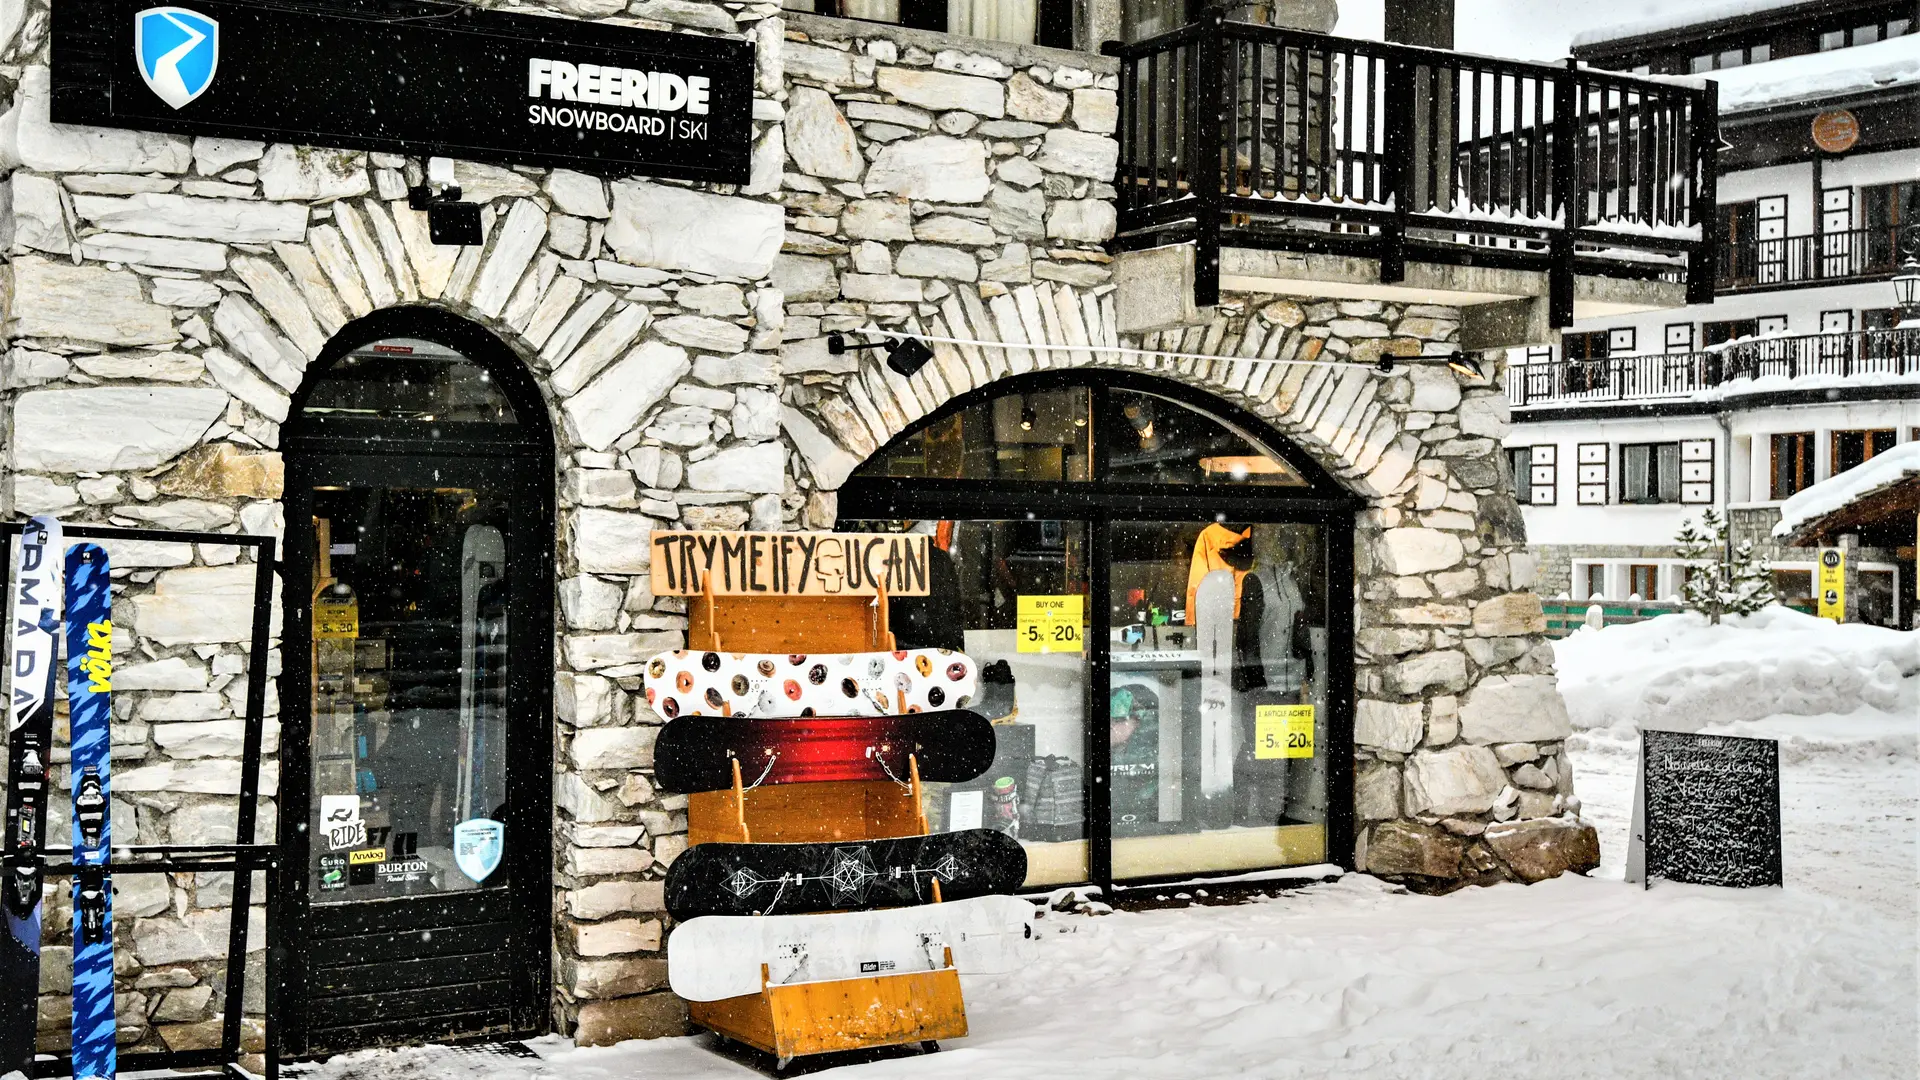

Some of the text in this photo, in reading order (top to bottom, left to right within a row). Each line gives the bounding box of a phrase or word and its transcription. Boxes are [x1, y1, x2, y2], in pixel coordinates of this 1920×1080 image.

[528, 57, 710, 115] FREERIDE
[528, 105, 708, 141] SNOWBOARD SKI
[1021, 625, 1044, 641] -5%
[1051, 625, 1081, 641] -20%
[1288, 708, 1312, 717] ACHETÉ
[1260, 733, 1280, 748] -5%
[1285, 732, 1312, 748] -20%
[330, 821, 365, 848] RIDE
[352, 851, 384, 861] Analog
[378, 861, 428, 873] BURTON
[862, 963, 877, 971] Ride
